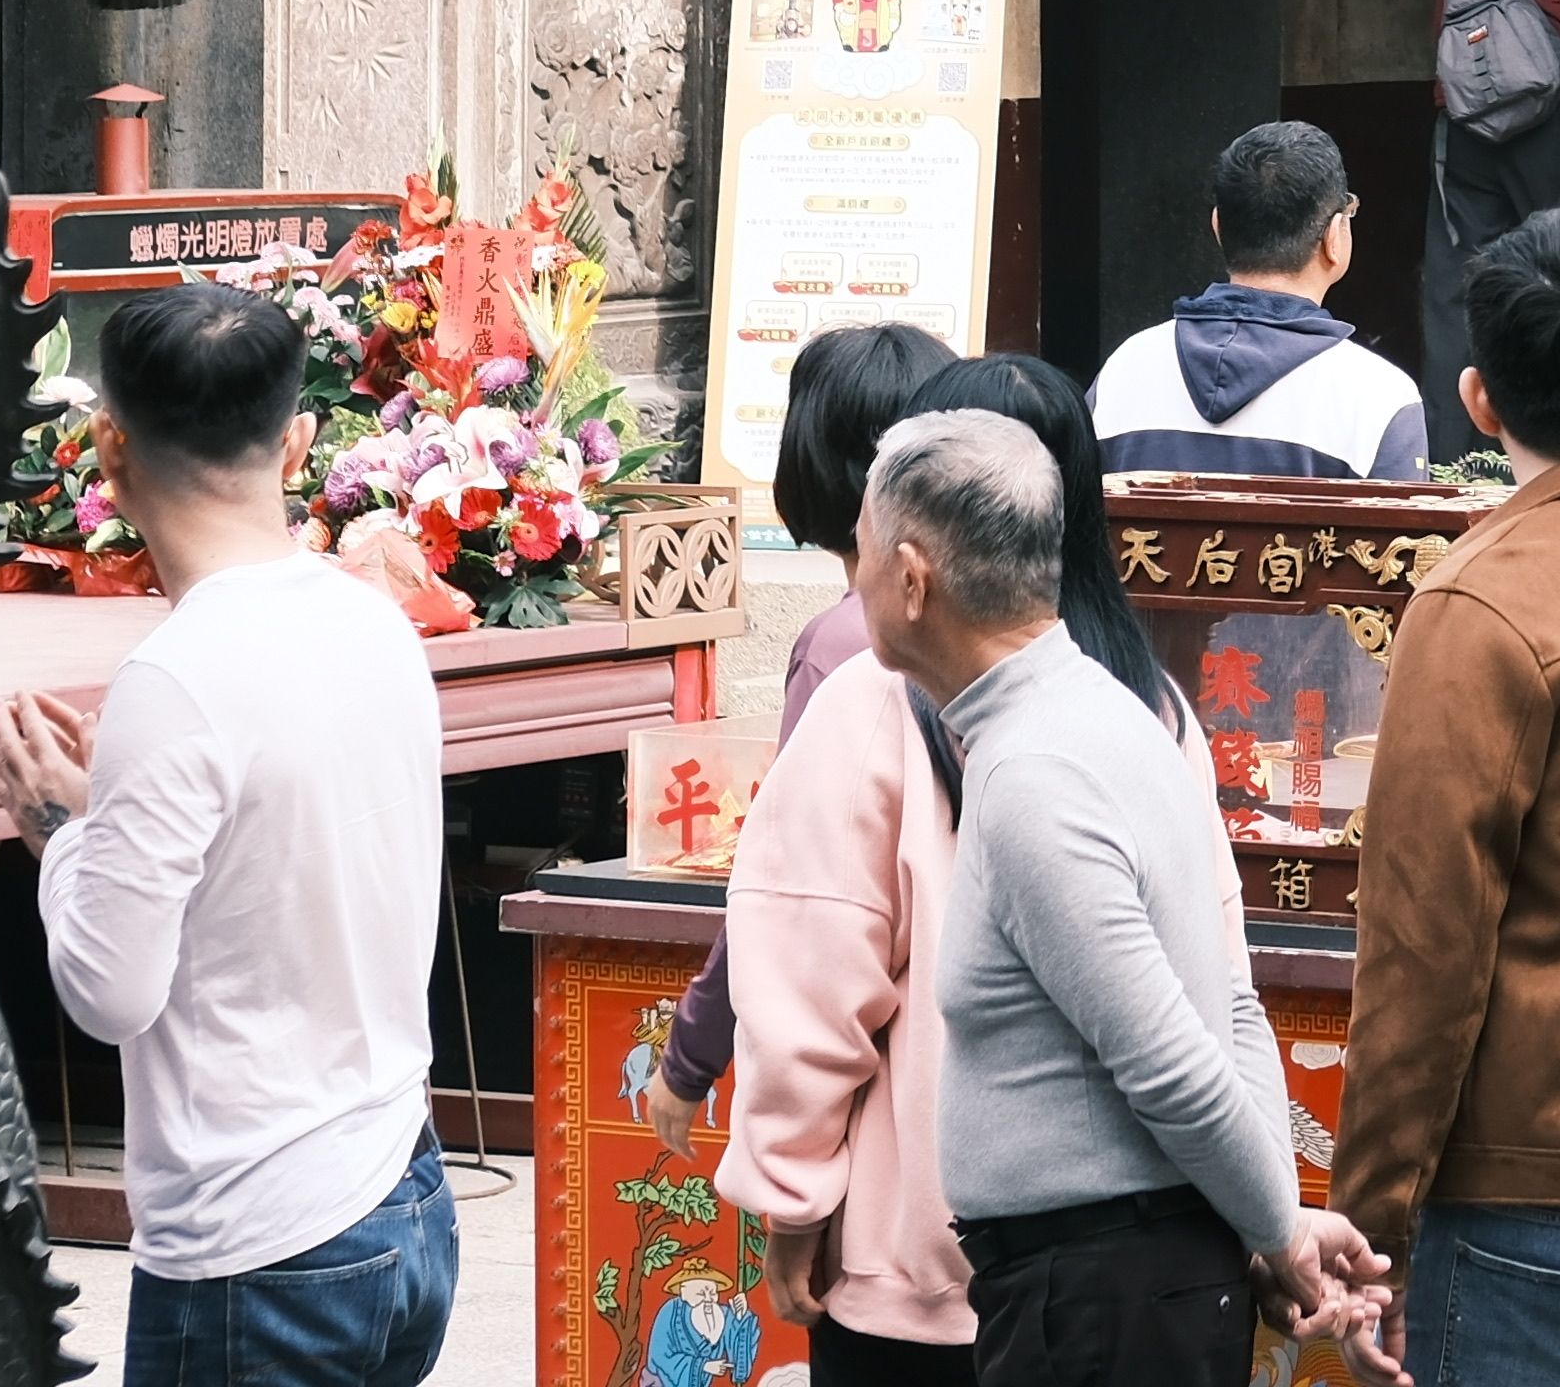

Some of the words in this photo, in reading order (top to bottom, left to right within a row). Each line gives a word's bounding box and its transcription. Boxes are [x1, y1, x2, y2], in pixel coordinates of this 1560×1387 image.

[472, 236, 501, 356] 香火鼎盛
[1120, 527, 1304, 594] 天后宮
[1269, 858, 1314, 910] 箱
